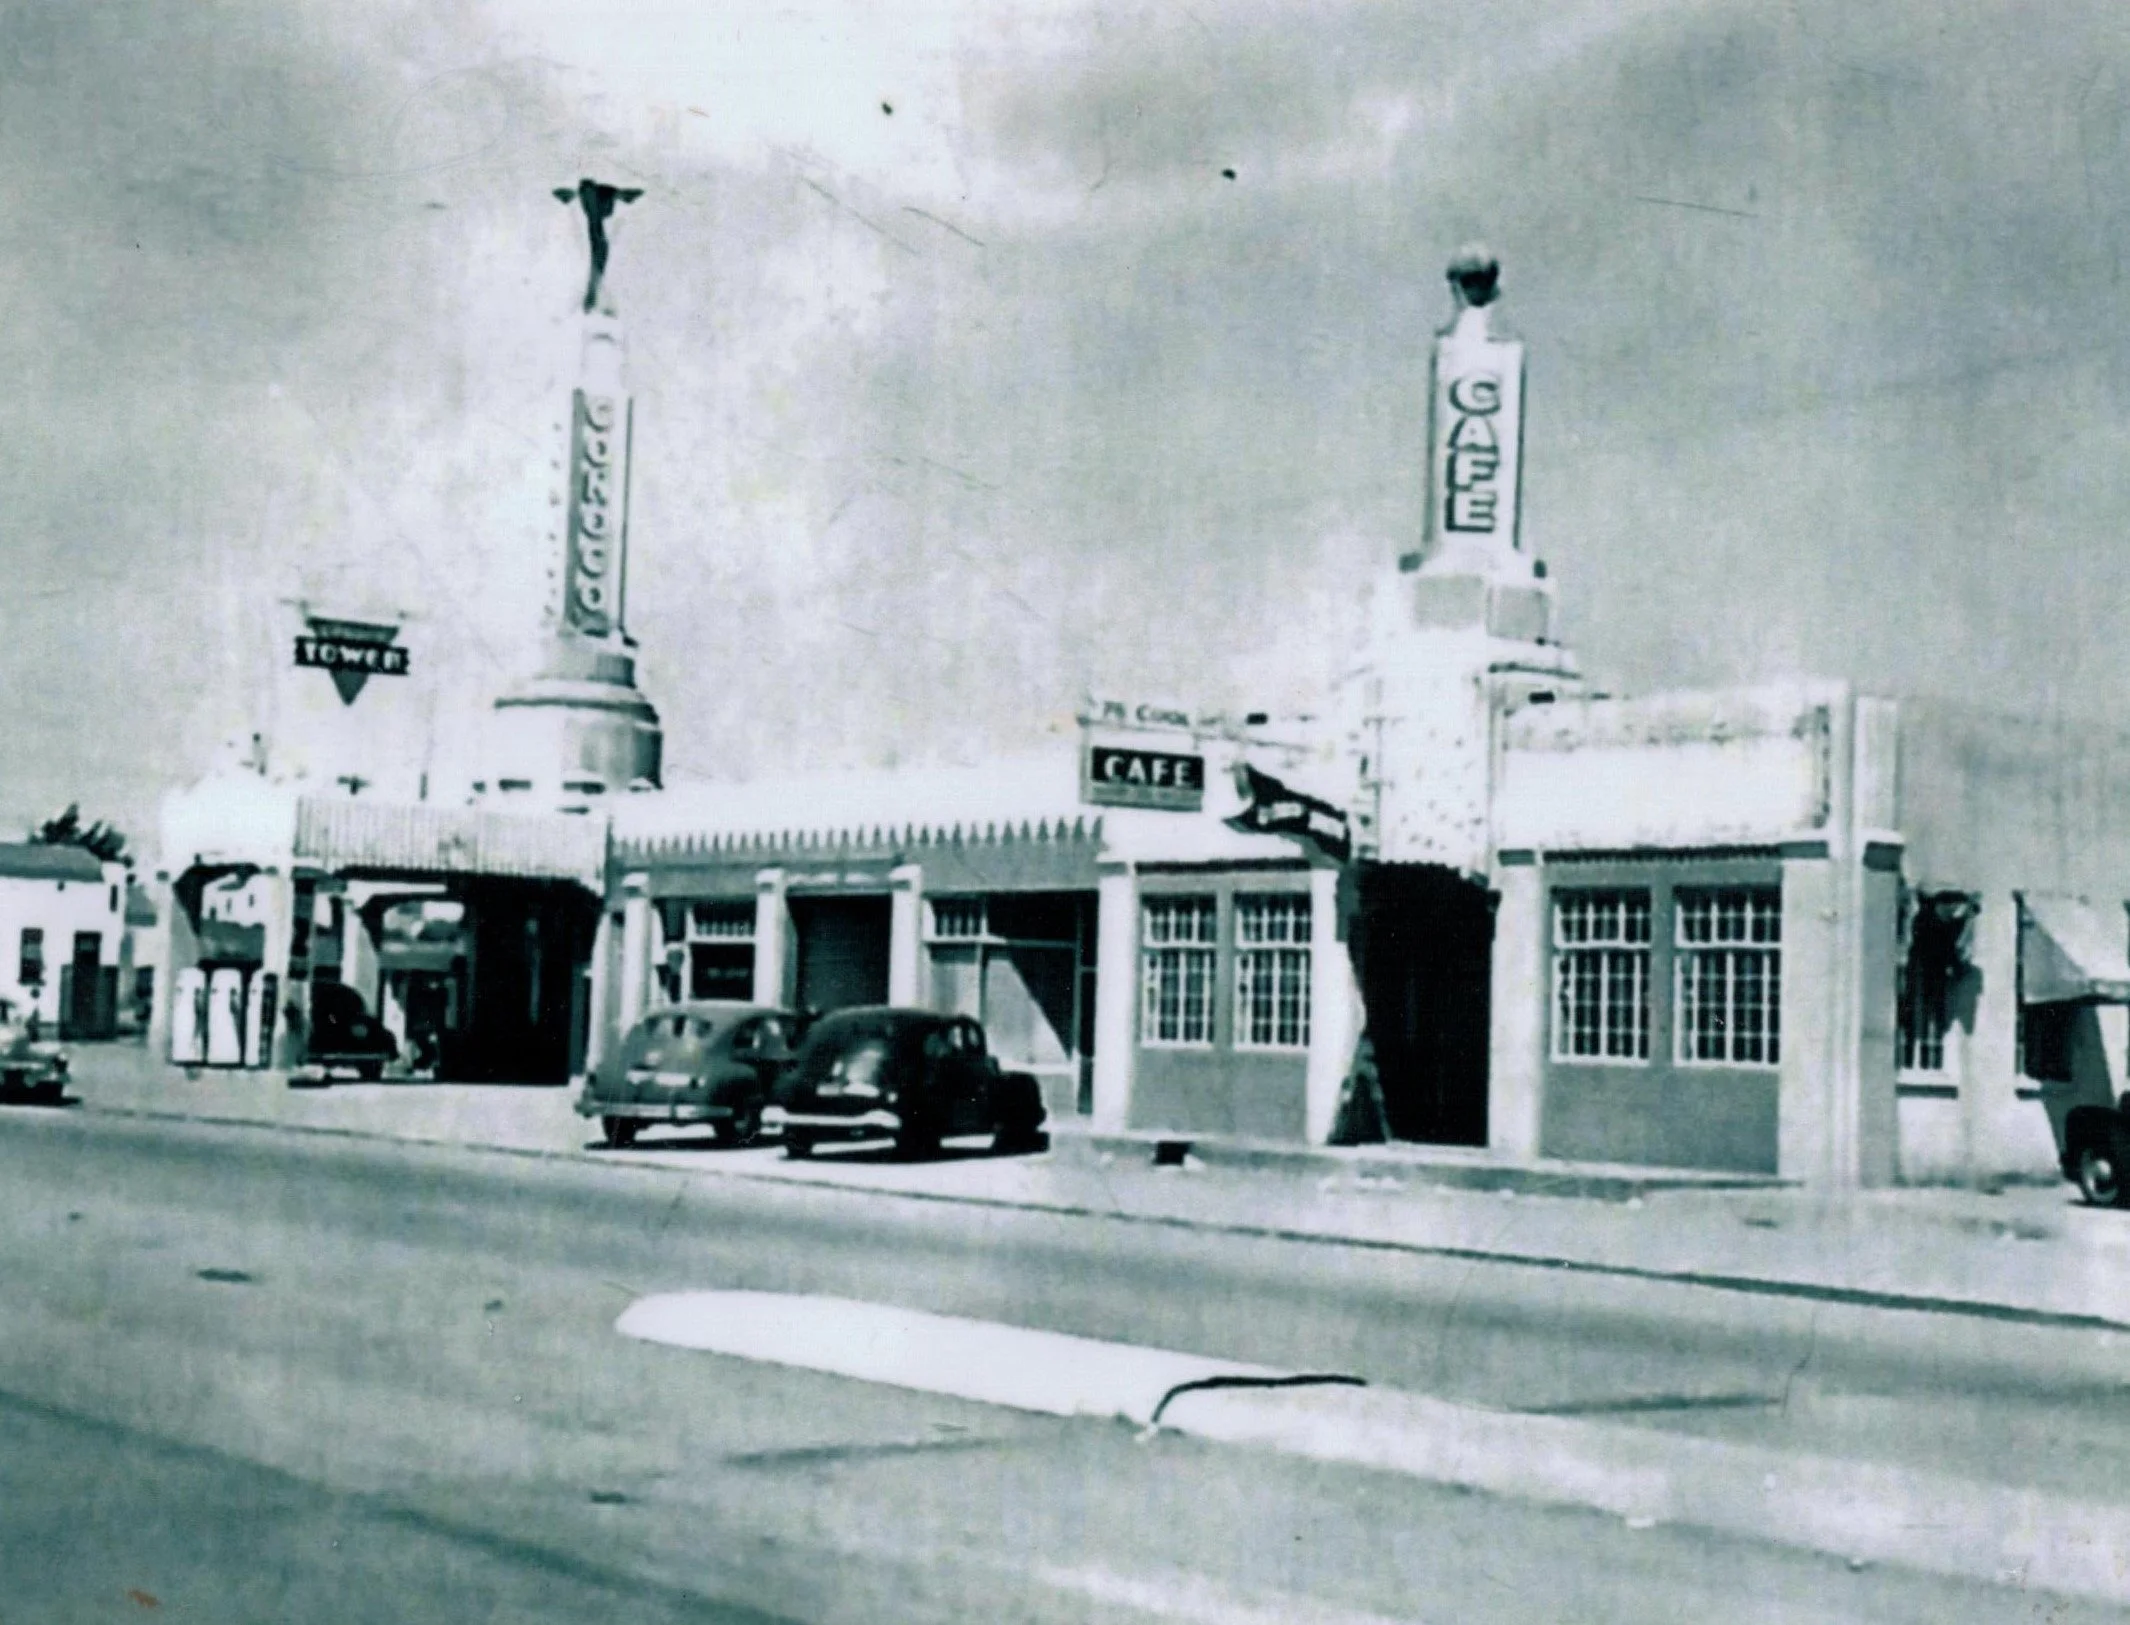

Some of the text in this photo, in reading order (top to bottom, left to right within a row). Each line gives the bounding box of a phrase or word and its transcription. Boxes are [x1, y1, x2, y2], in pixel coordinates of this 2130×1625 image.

[1446, 373, 1501, 534] CAFE
[304, 640, 401, 669] TOWER
[1103, 755, 1193, 788] CAFE
